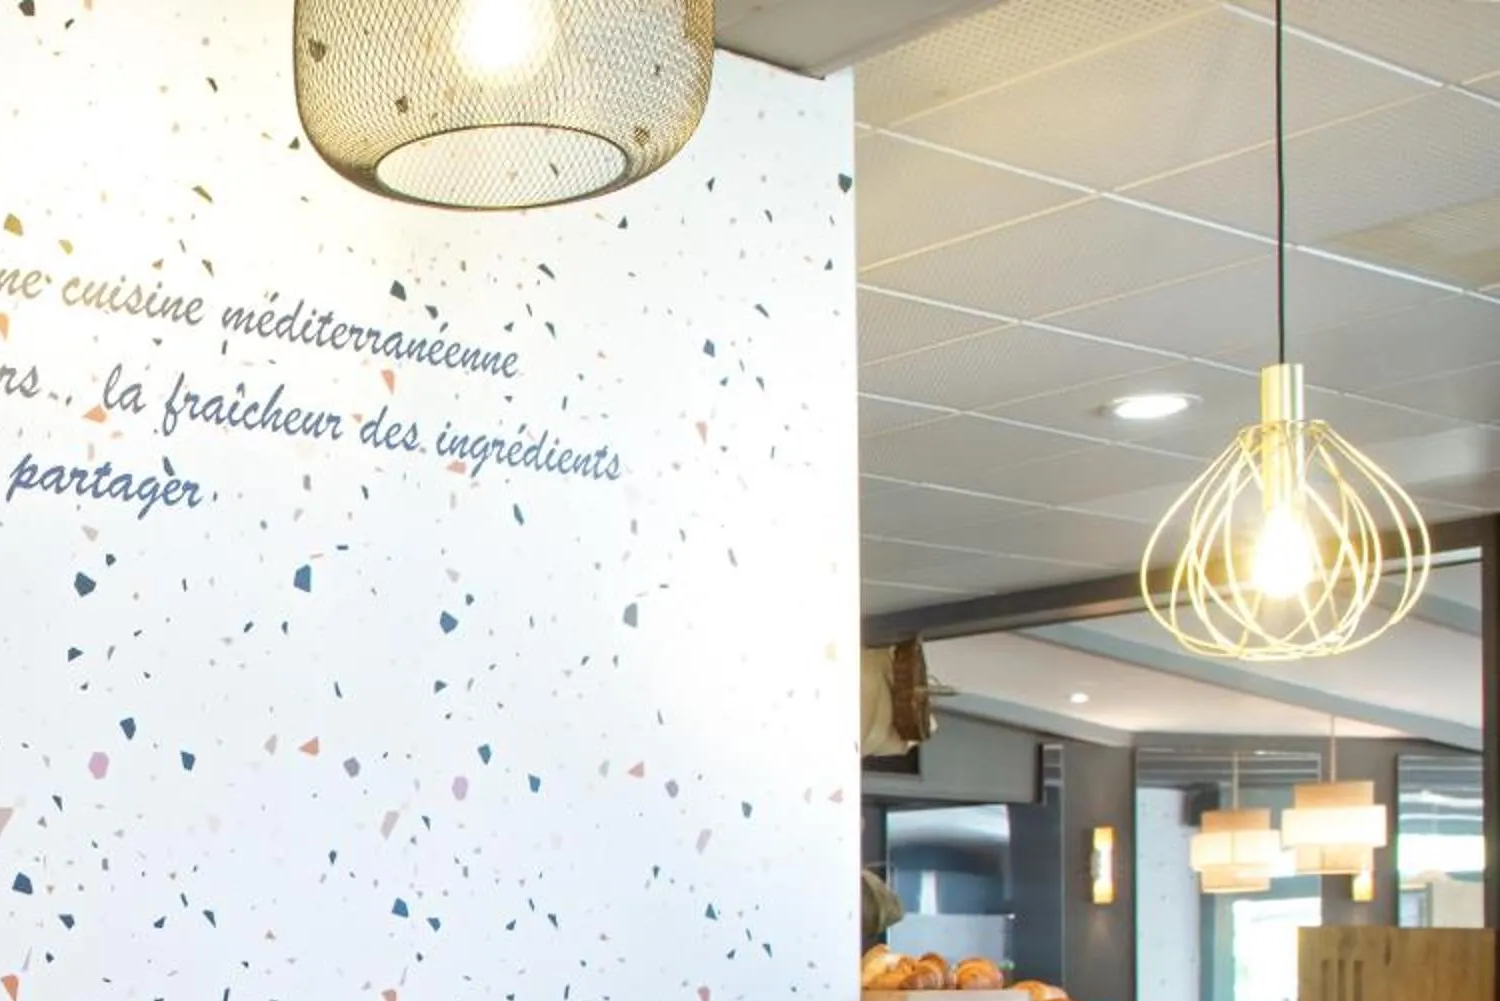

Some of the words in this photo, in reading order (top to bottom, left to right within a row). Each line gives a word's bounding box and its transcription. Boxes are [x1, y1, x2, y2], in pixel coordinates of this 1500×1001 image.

[60, 274, 206, 326] cuisine
[220, 291, 521, 379] méditerranéenne
[102, 363, 147, 415] la
[162, 371, 343, 441] fraîcheur
[359, 405, 420, 451] des
[435, 420, 621, 480] ingrédients
